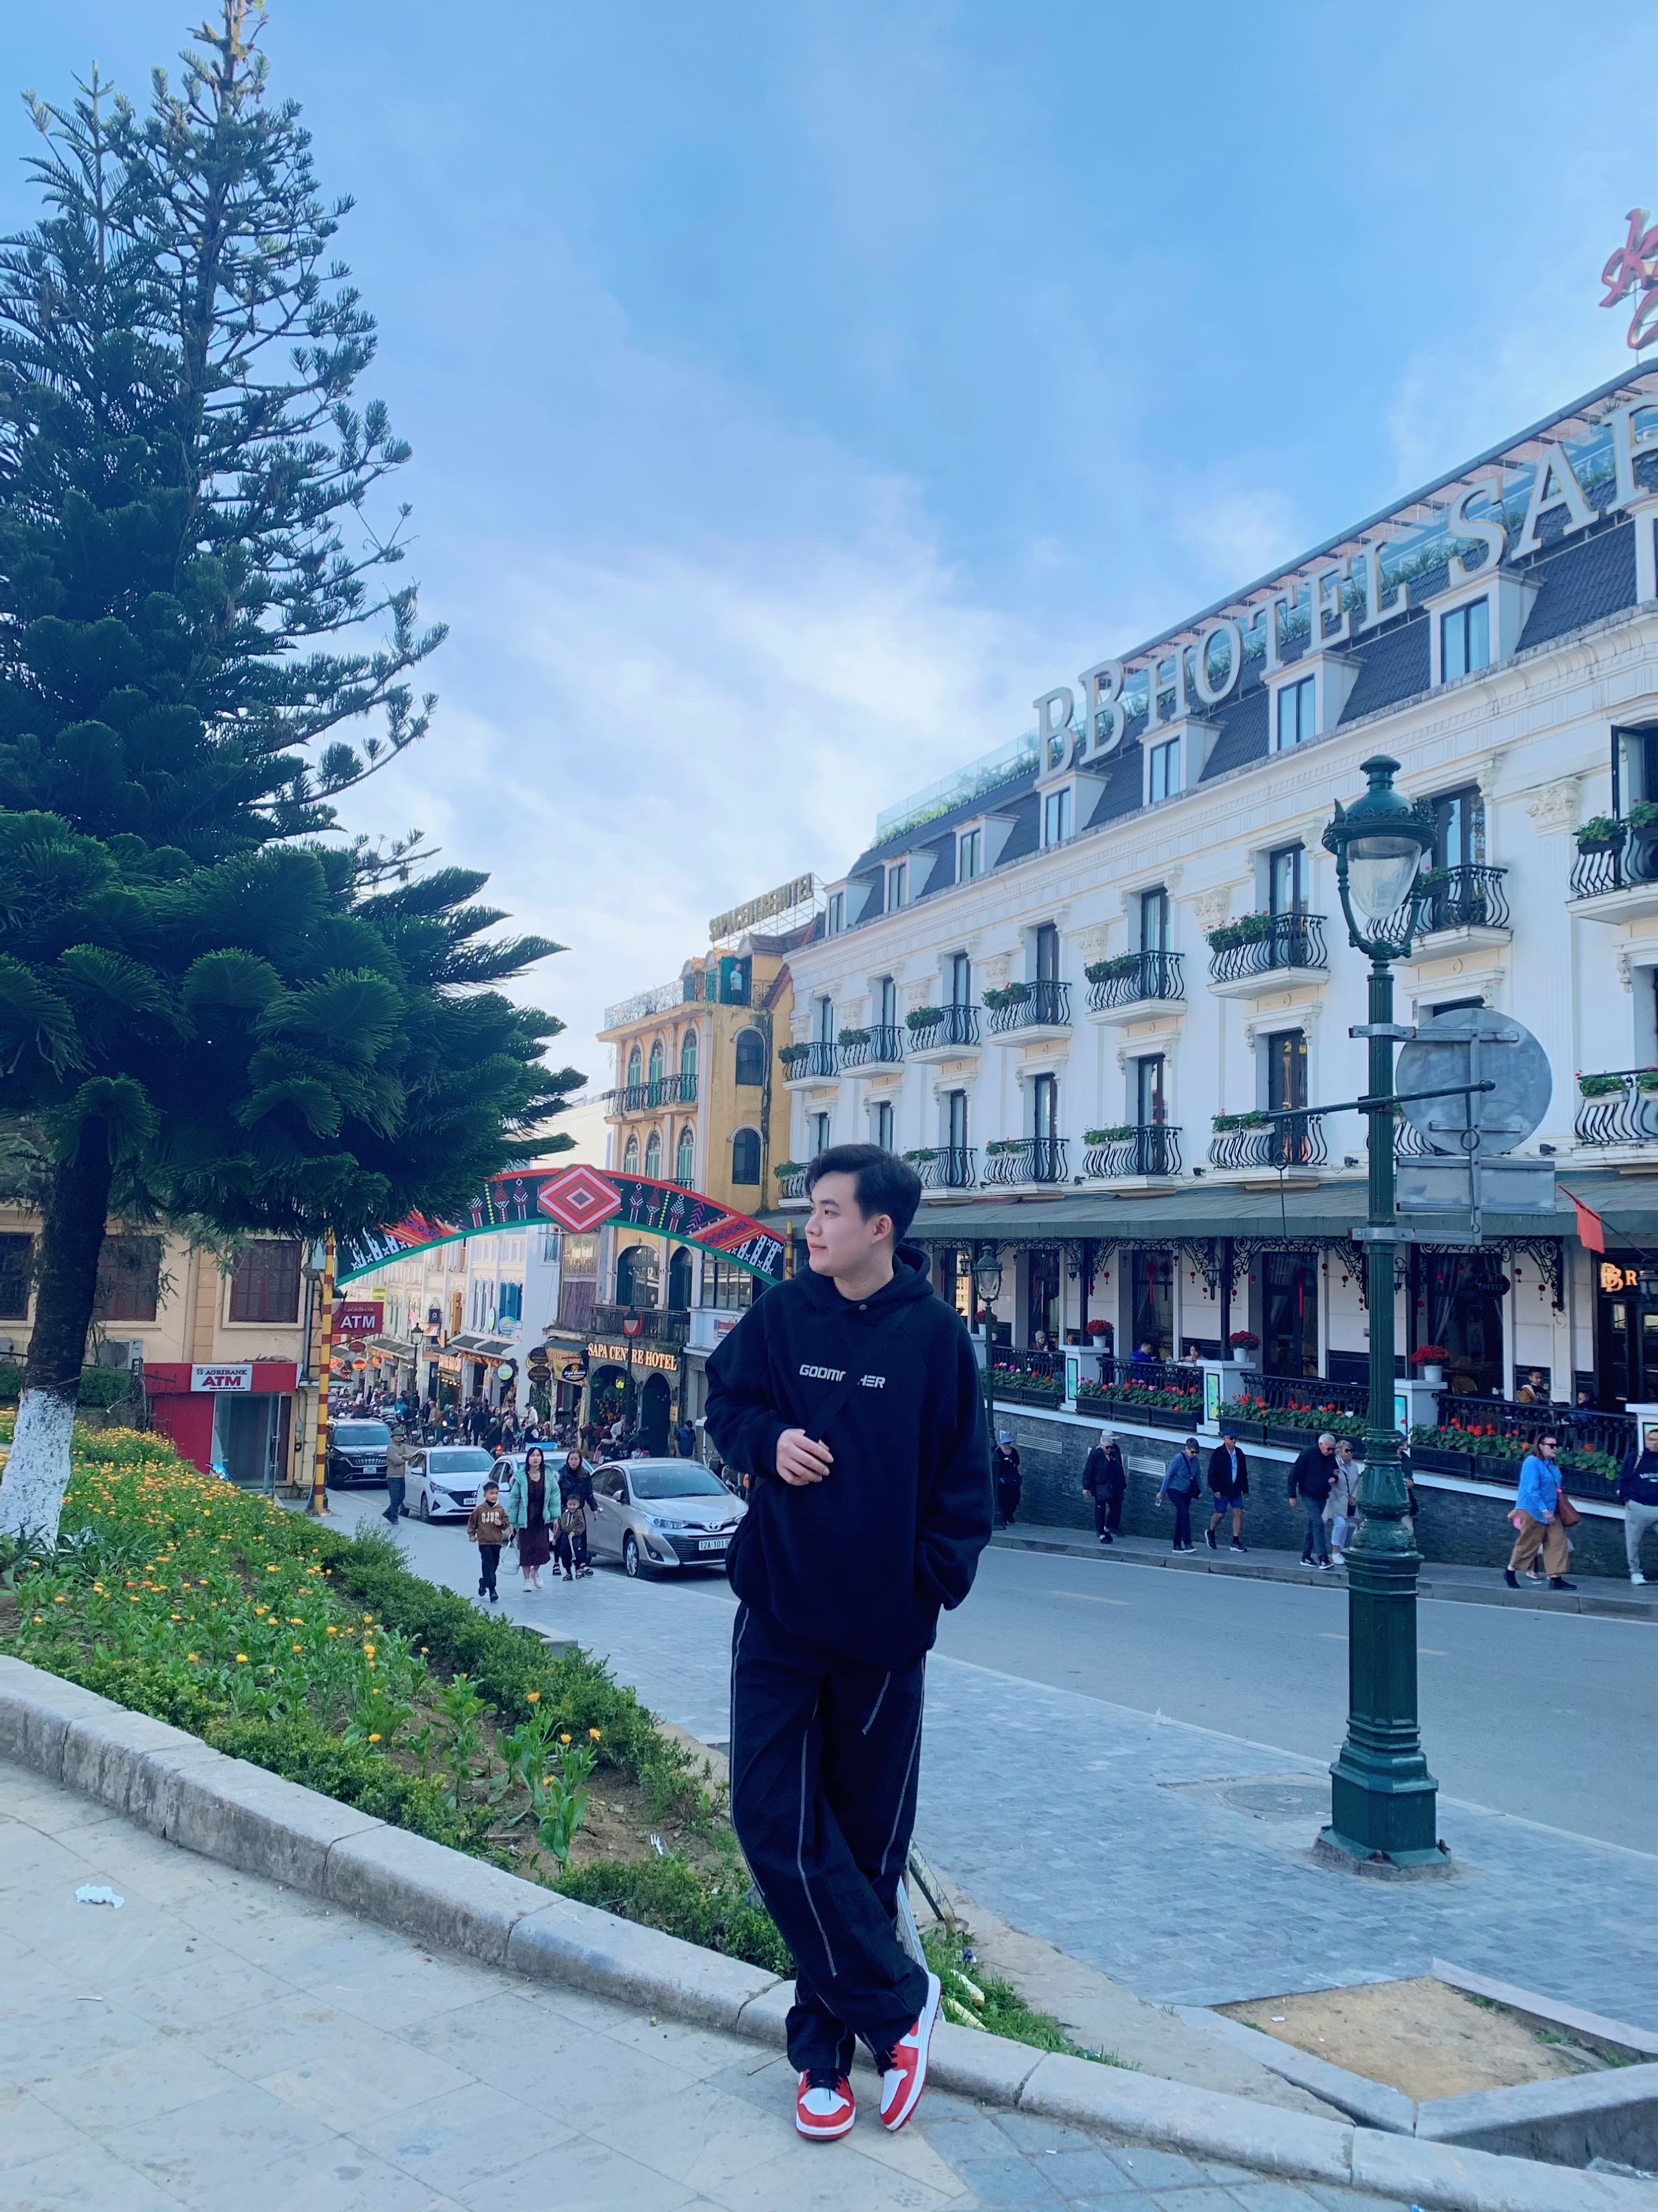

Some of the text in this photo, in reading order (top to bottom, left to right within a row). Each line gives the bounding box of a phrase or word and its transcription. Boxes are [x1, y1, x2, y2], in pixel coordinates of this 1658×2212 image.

[1032, 659, 1126, 774] BB
[1136, 539, 1411, 736] HOTEL
[340, 1315, 375, 1329] ATM
[588, 1342, 608, 1359] SAPA
[609, 1345, 644, 1365] CENRE
[645, 1351, 677, 1371] HOTEL
[201, 1376, 241, 1387] ATM
